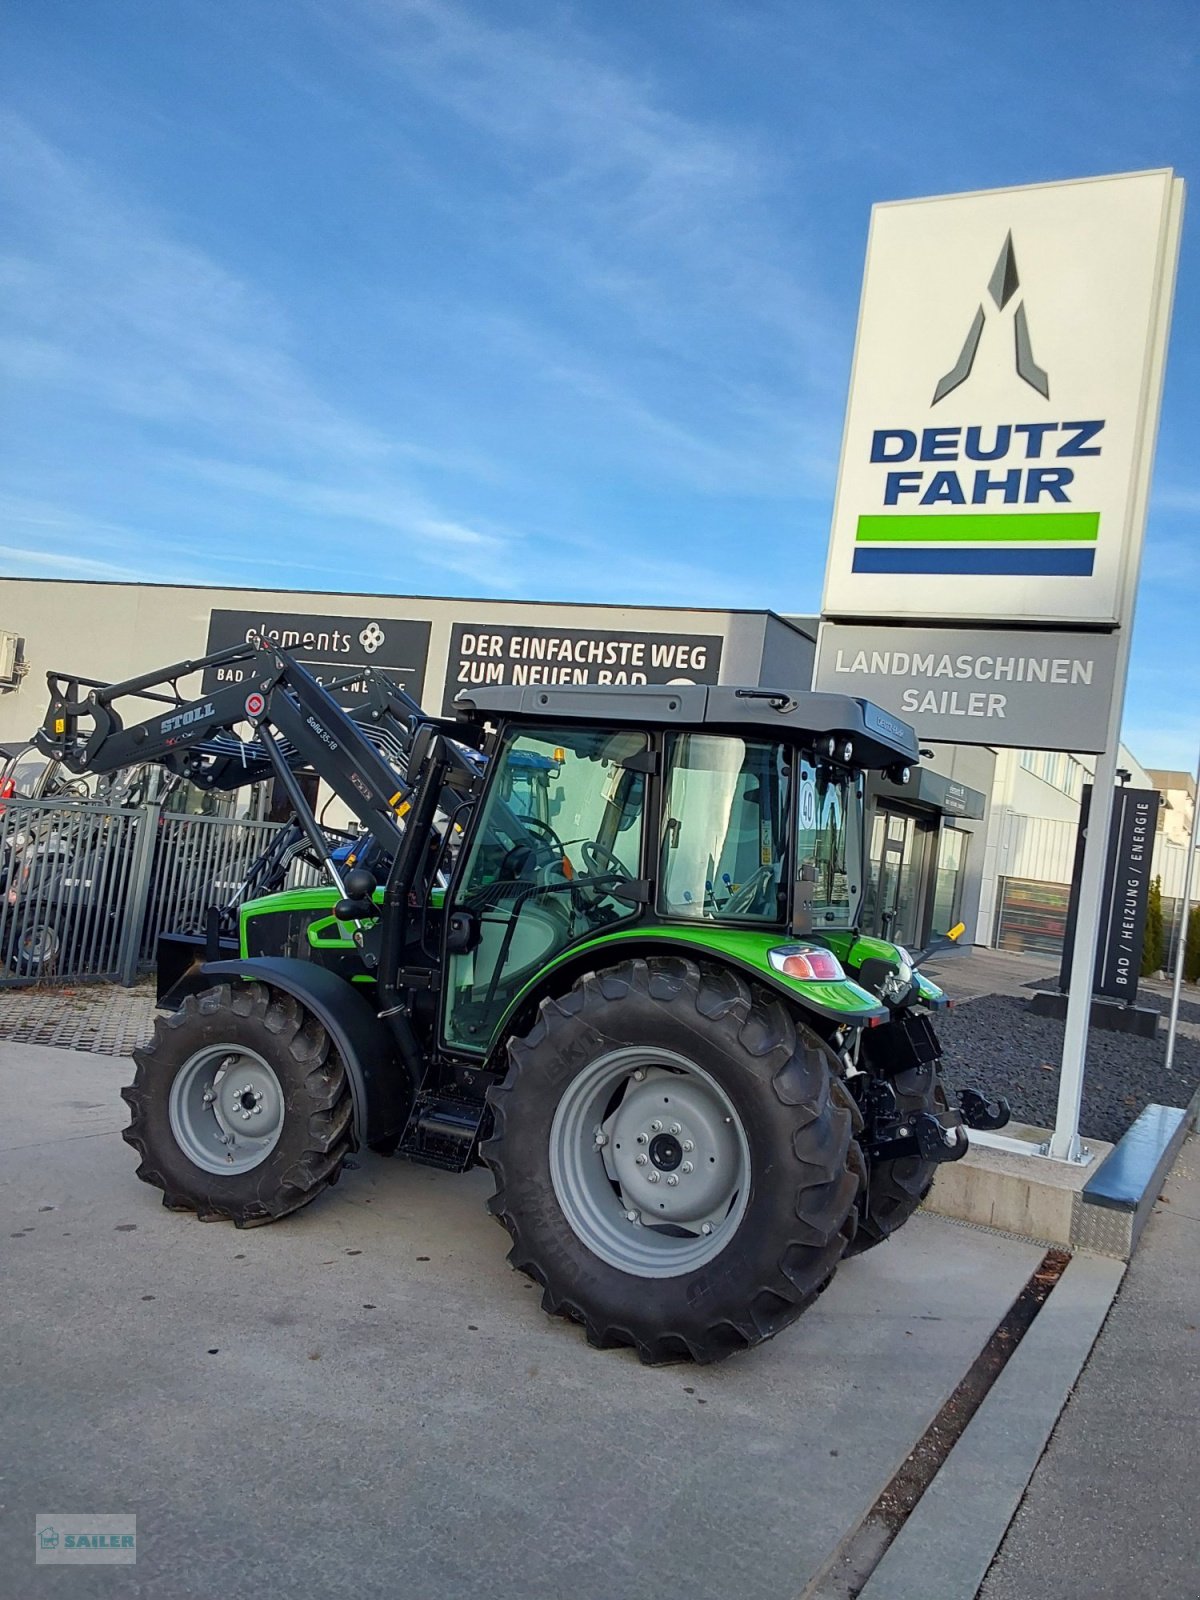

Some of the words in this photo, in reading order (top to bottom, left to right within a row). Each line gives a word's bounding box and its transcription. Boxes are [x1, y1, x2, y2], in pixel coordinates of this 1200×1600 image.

[869, 419, 1106, 464] DEUTZ
[883, 467, 1075, 506] FAHR
[460, 633, 504, 658] DER
[508, 636, 646, 667] EINFACHSTE
[651, 644, 707, 671] WEG
[834, 649, 1095, 686] LANDMASCHINEN
[216, 668, 244, 683] BAD
[457, 660, 505, 685] ZUM
[512, 664, 589, 686] NEUEN
[597, 670, 648, 686] BAD
[160, 702, 216, 735] STOLL
[900, 688, 1008, 719] SAILER
[306, 716, 323, 734] Solid
[320, 730, 338, 751] 35-18
[803, 790, 813, 822] 40
[1130, 802, 1149, 862] ENERGIE
[1121, 878, 1139, 939] HEIZUNG
[1115, 957, 1130, 985] BAD
